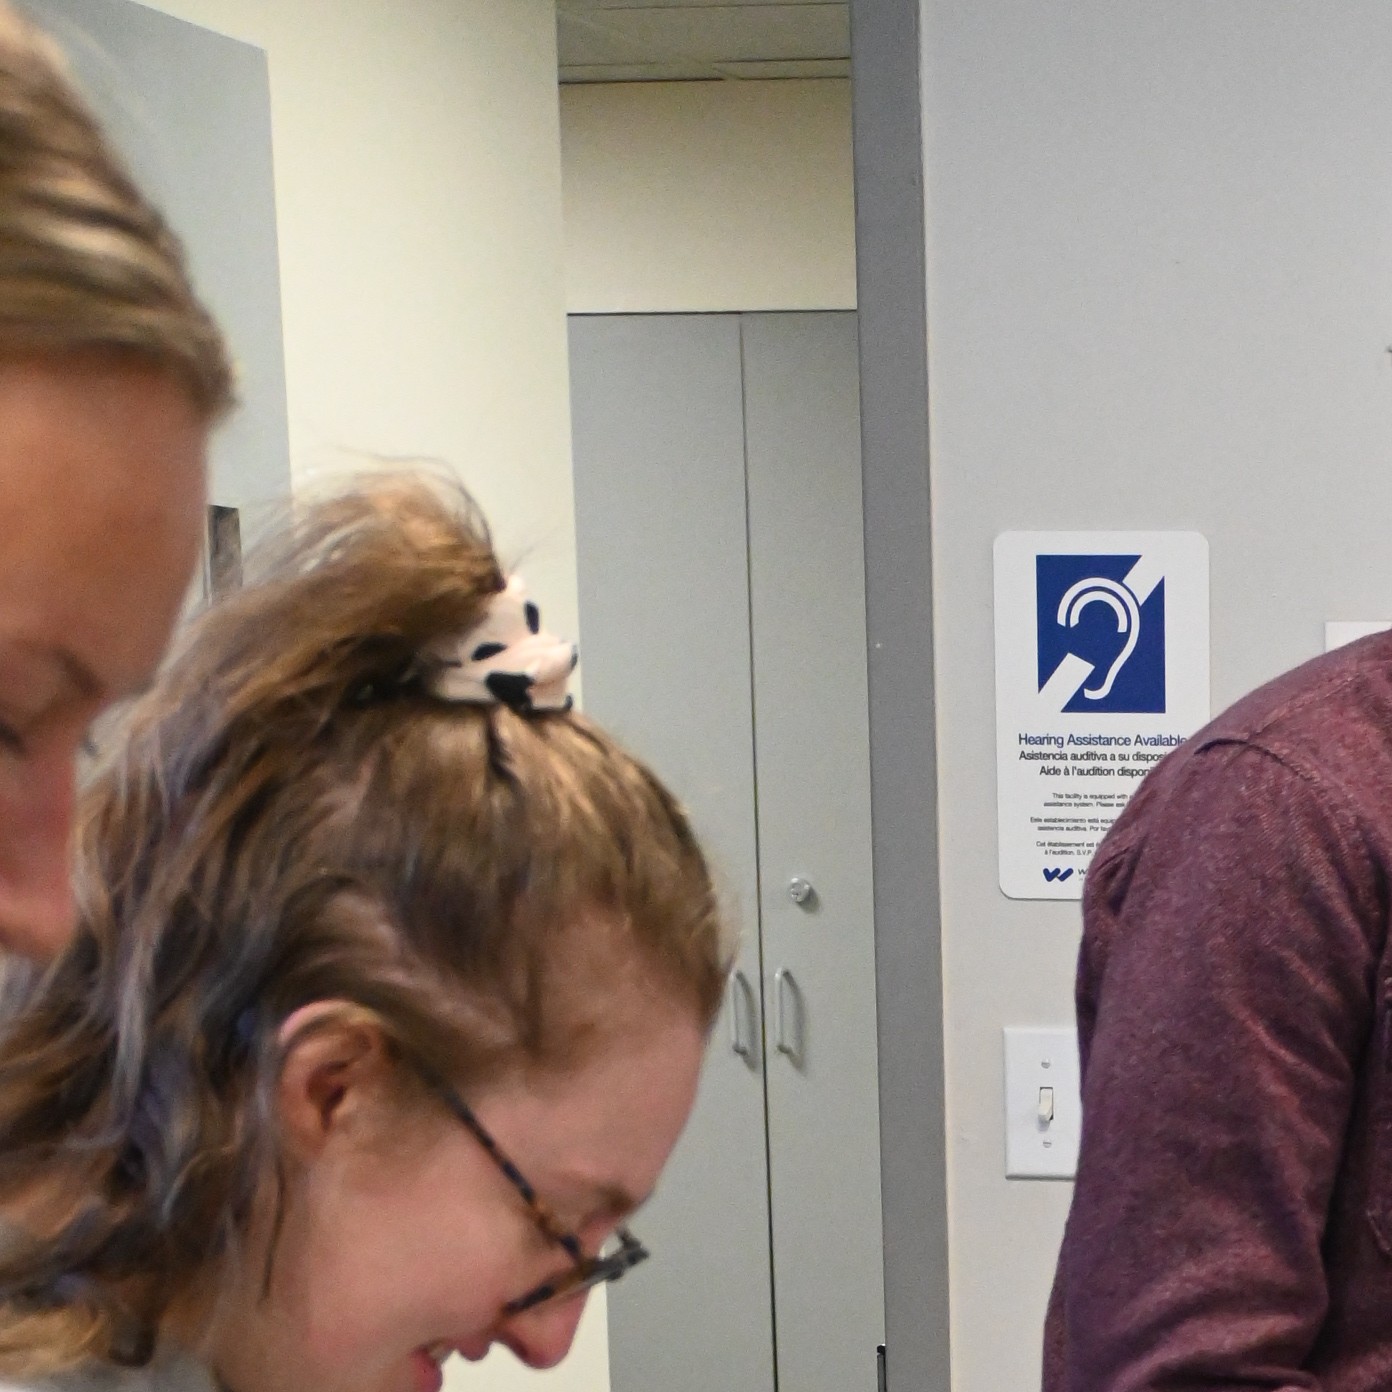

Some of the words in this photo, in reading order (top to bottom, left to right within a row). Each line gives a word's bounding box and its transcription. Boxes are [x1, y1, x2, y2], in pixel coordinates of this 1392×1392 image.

[1018, 733, 1064, 748] Hearing
[1067, 733, 1131, 747] Assistance
[1019, 751, 1068, 762] Asistencia
[1070, 751, 1108, 762] auditiva
[1110, 753, 1116, 762] a
[1118, 753, 1130, 762] su
[1039, 766, 1062, 777] Aide
[1071, 766, 1115, 777] l'audition
